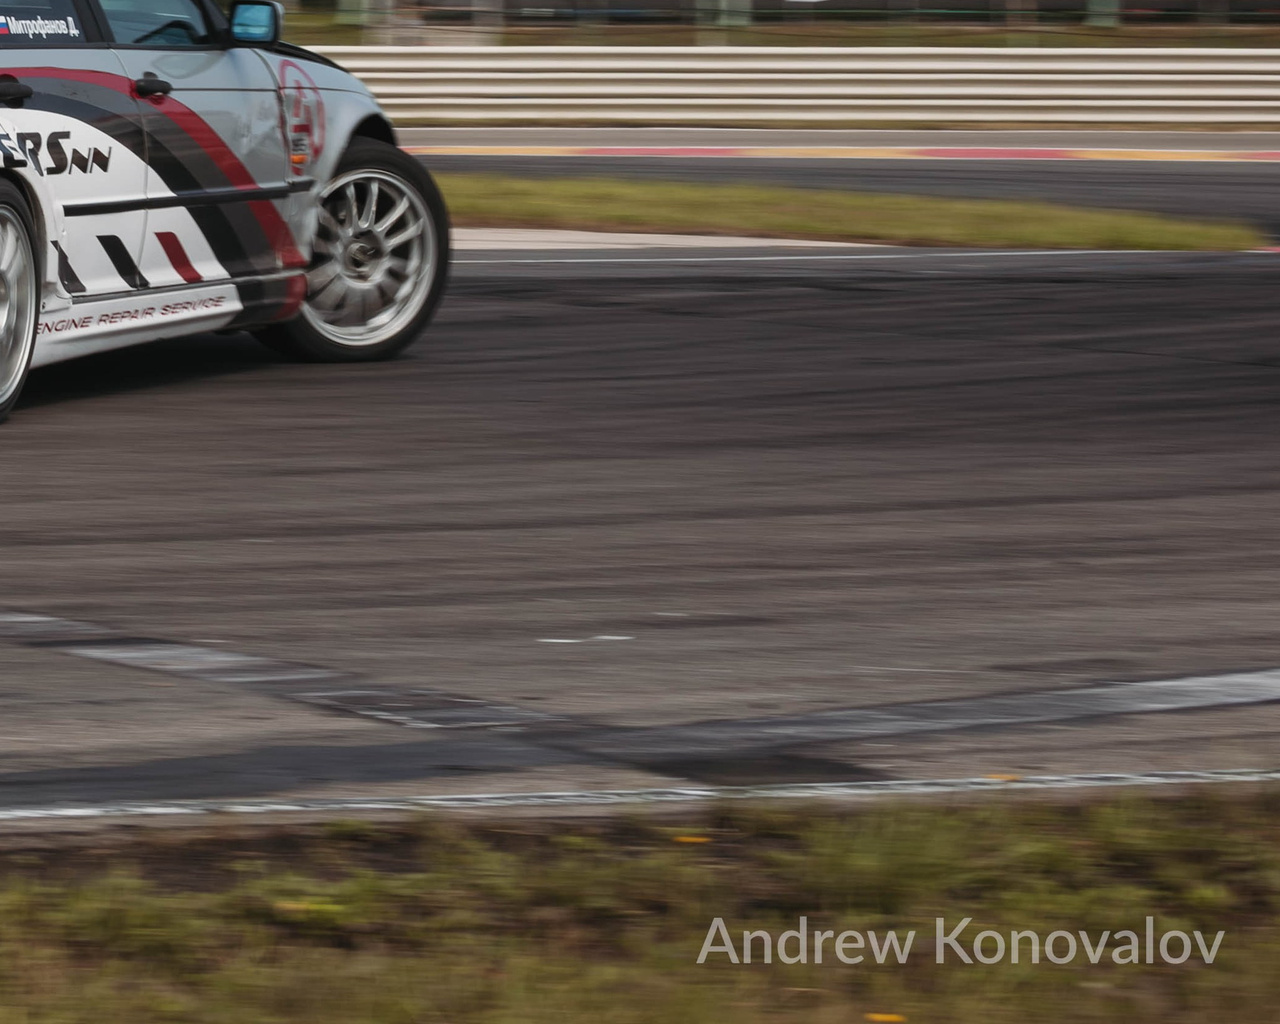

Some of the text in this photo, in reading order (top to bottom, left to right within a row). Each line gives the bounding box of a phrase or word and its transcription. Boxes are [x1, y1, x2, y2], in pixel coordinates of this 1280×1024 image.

[6, 15, 69, 39] Митрофанов
[97, 307, 156, 326] REPAIR
[160, 296, 227, 317] SERVICE
